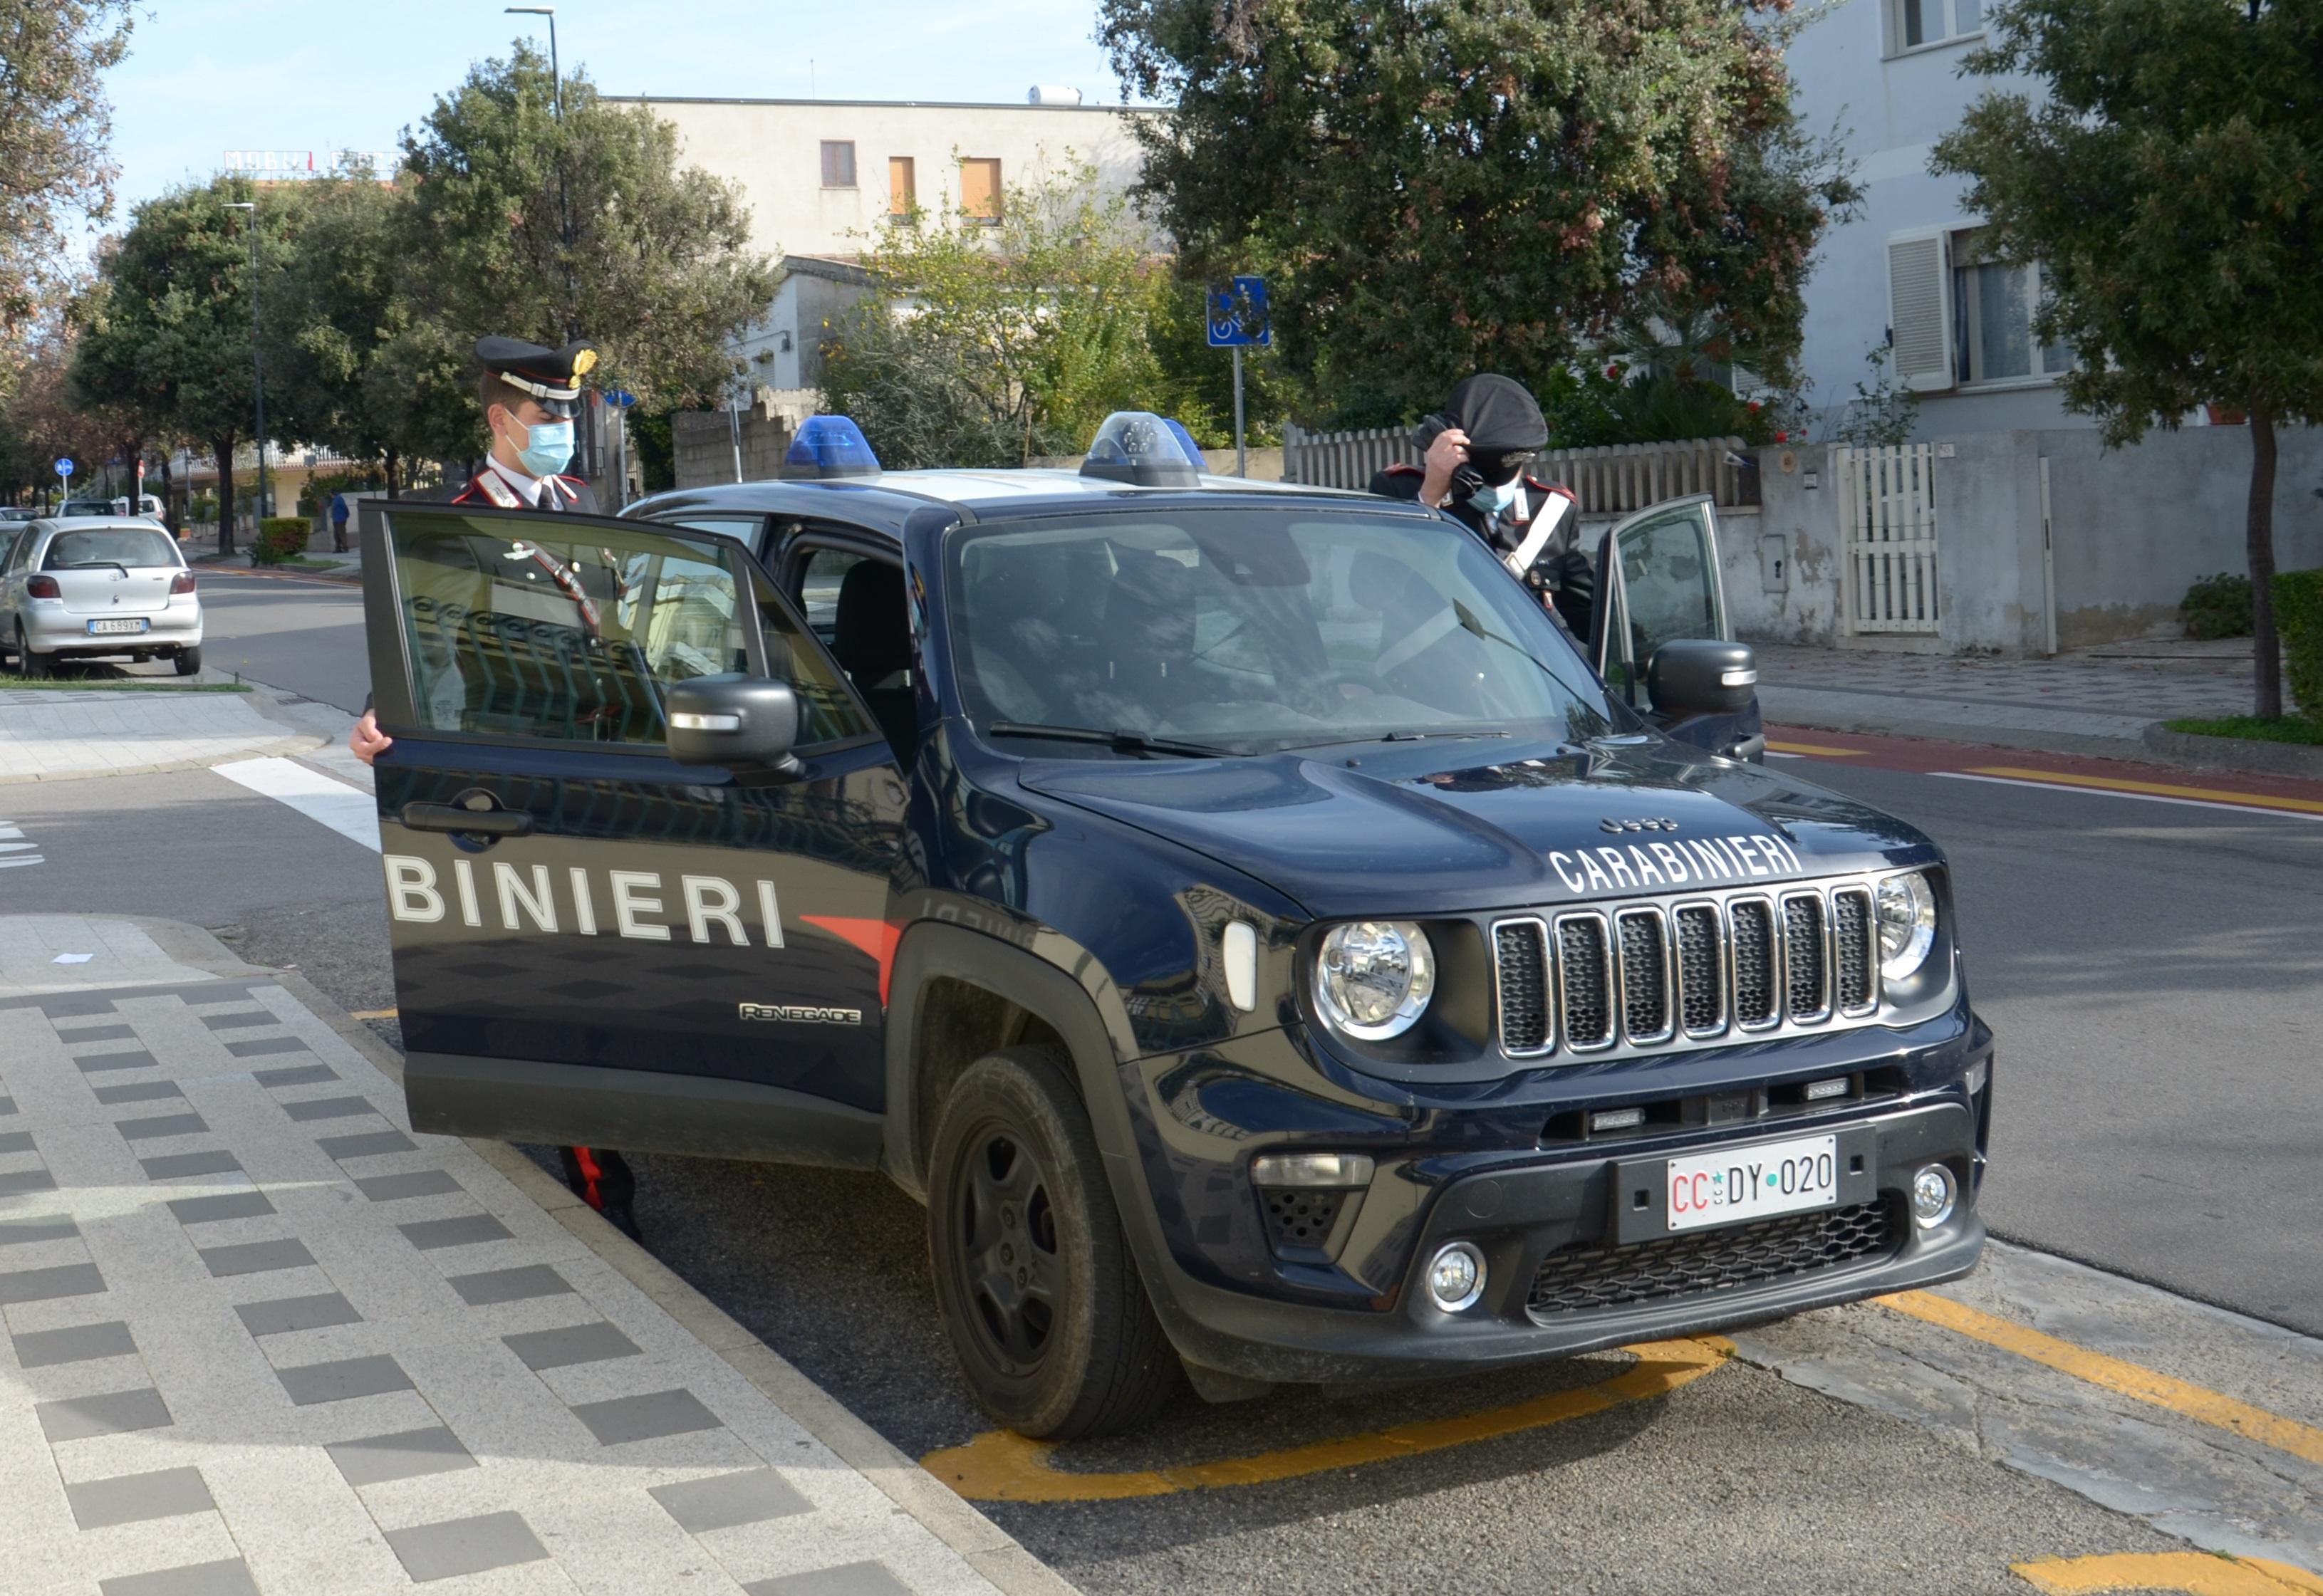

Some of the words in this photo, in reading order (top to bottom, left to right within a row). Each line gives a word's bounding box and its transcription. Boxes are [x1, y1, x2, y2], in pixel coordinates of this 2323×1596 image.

[1599, 817, 1678, 834] Jeep
[1549, 835, 1802, 893] CARABINIERI
[383, 854, 784, 949] BINIERI
[739, 1003, 861, 1025] RENEGADE
[1673, 1173, 1708, 1212] CC
[1728, 1162, 1762, 1204] DY
[1781, 1152, 1832, 1196] 020
